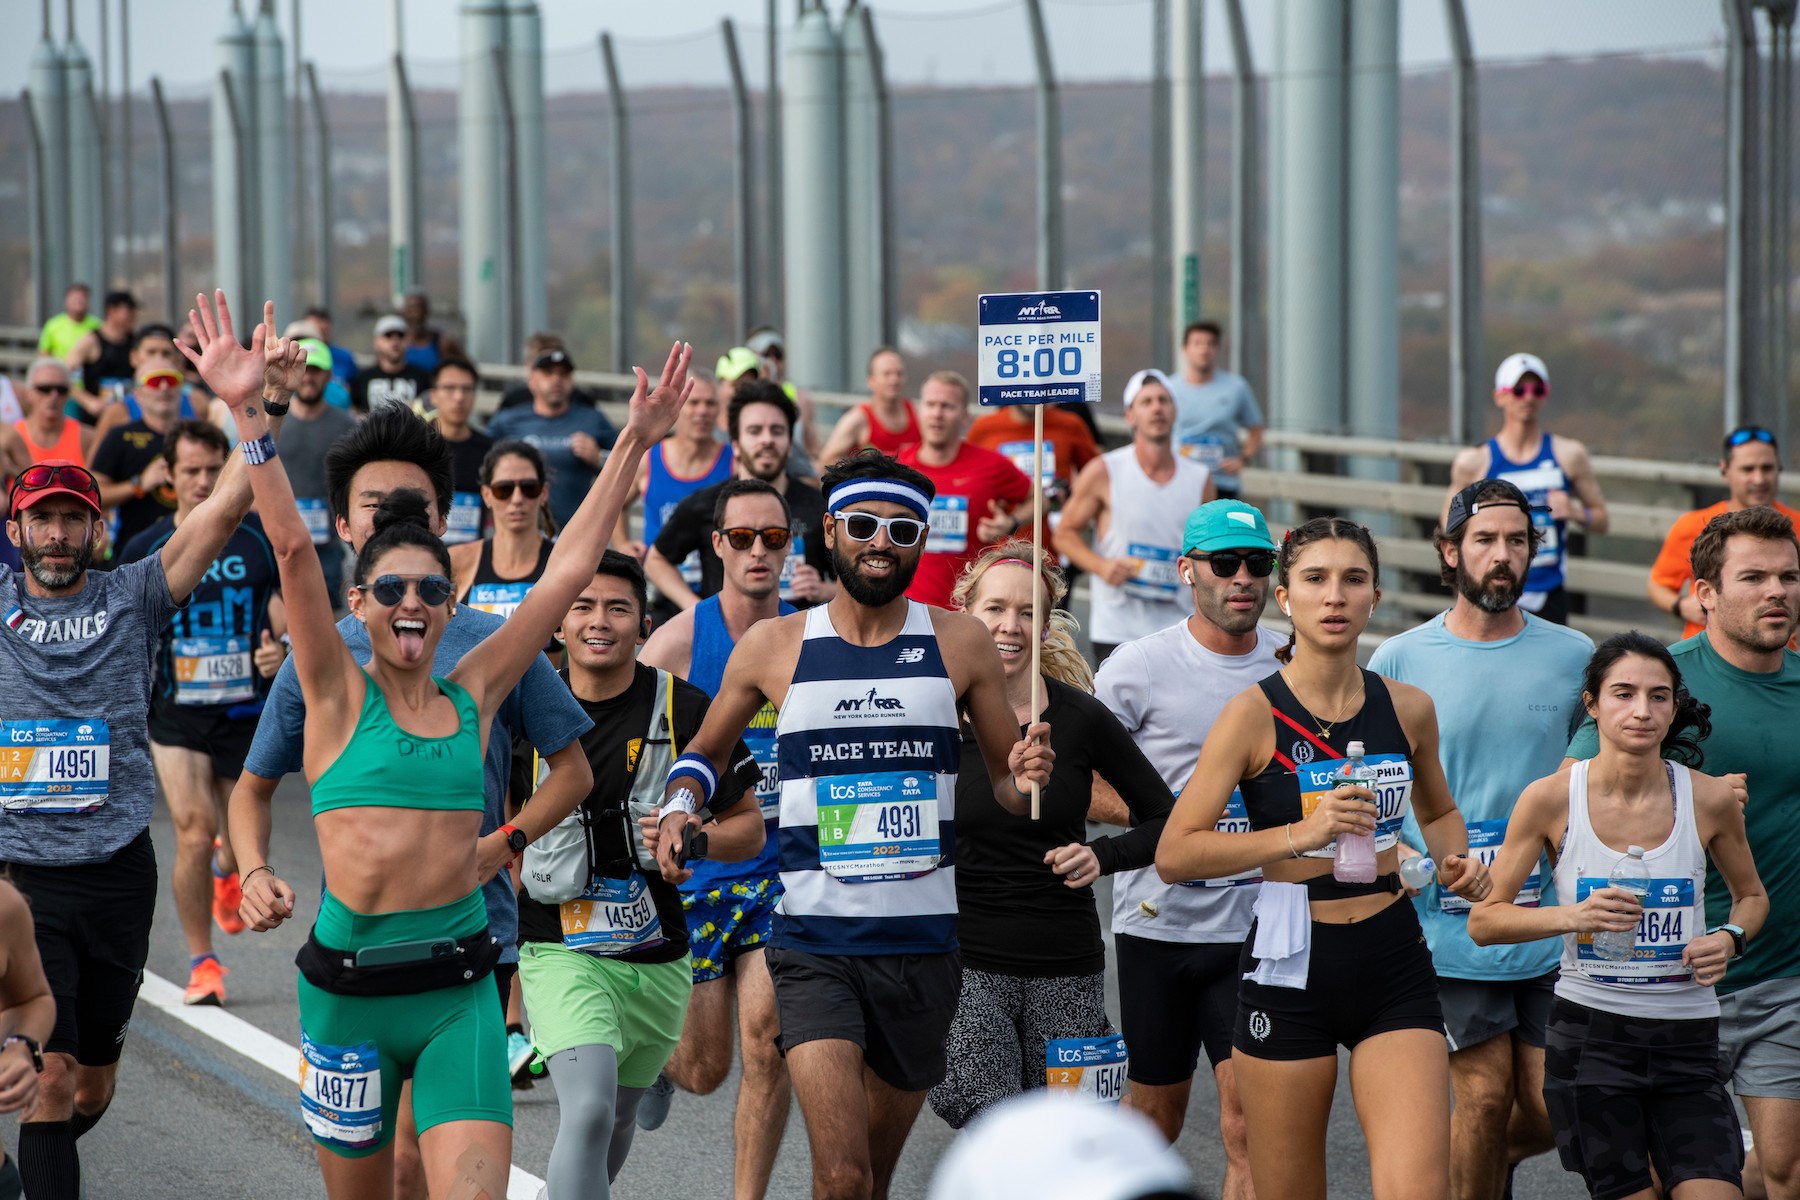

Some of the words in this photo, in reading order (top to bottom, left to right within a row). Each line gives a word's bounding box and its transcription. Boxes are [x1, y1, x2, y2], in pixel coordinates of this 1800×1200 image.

[1018, 305, 1061, 315] NYRR
[985, 336, 1022, 346] PACE
[1028, 334, 1054, 345] PER
[1060, 333, 1095, 343] MILE
[997, 347, 1082, 378] 8:00
[1001, 390, 1022, 398] PACE
[1024, 390, 1046, 398] TEAM
[1047, 388, 1079, 396] LEADER
[17, 610, 107, 643] FRANCE
[207, 656, 243, 678] 14528
[834, 697, 905, 711] NYRR
[11, 728, 34, 743] tcs
[12, 751, 20, 761] 2
[809, 742, 863, 762] PACE
[869, 741, 934, 759] TEAM
[1298, 746, 1308, 759] B
[49, 749, 96, 778] 14951
[12, 767, 22, 777] A
[1377, 766, 1404, 778] PHIA
[47, 785, 73, 793] 2022
[830, 784, 855, 799] tcs
[833, 809, 840, 821] 1
[876, 804, 920, 838] 4931
[833, 827, 843, 840] B
[873, 845, 901, 855] 2022
[531, 869, 552, 883] VSLR
[573, 903, 582, 914] 2
[605, 896, 651, 929] 14559
[575, 919, 584, 929] A
[611, 932, 635, 941] 2022
[1255, 1017, 1264, 1033] B
[1058, 1047, 1081, 1062] tcs
[1061, 1071, 1069, 1083] 2
[315, 1071, 368, 1108] 14877
[318, 1106, 339, 1121] 2022
